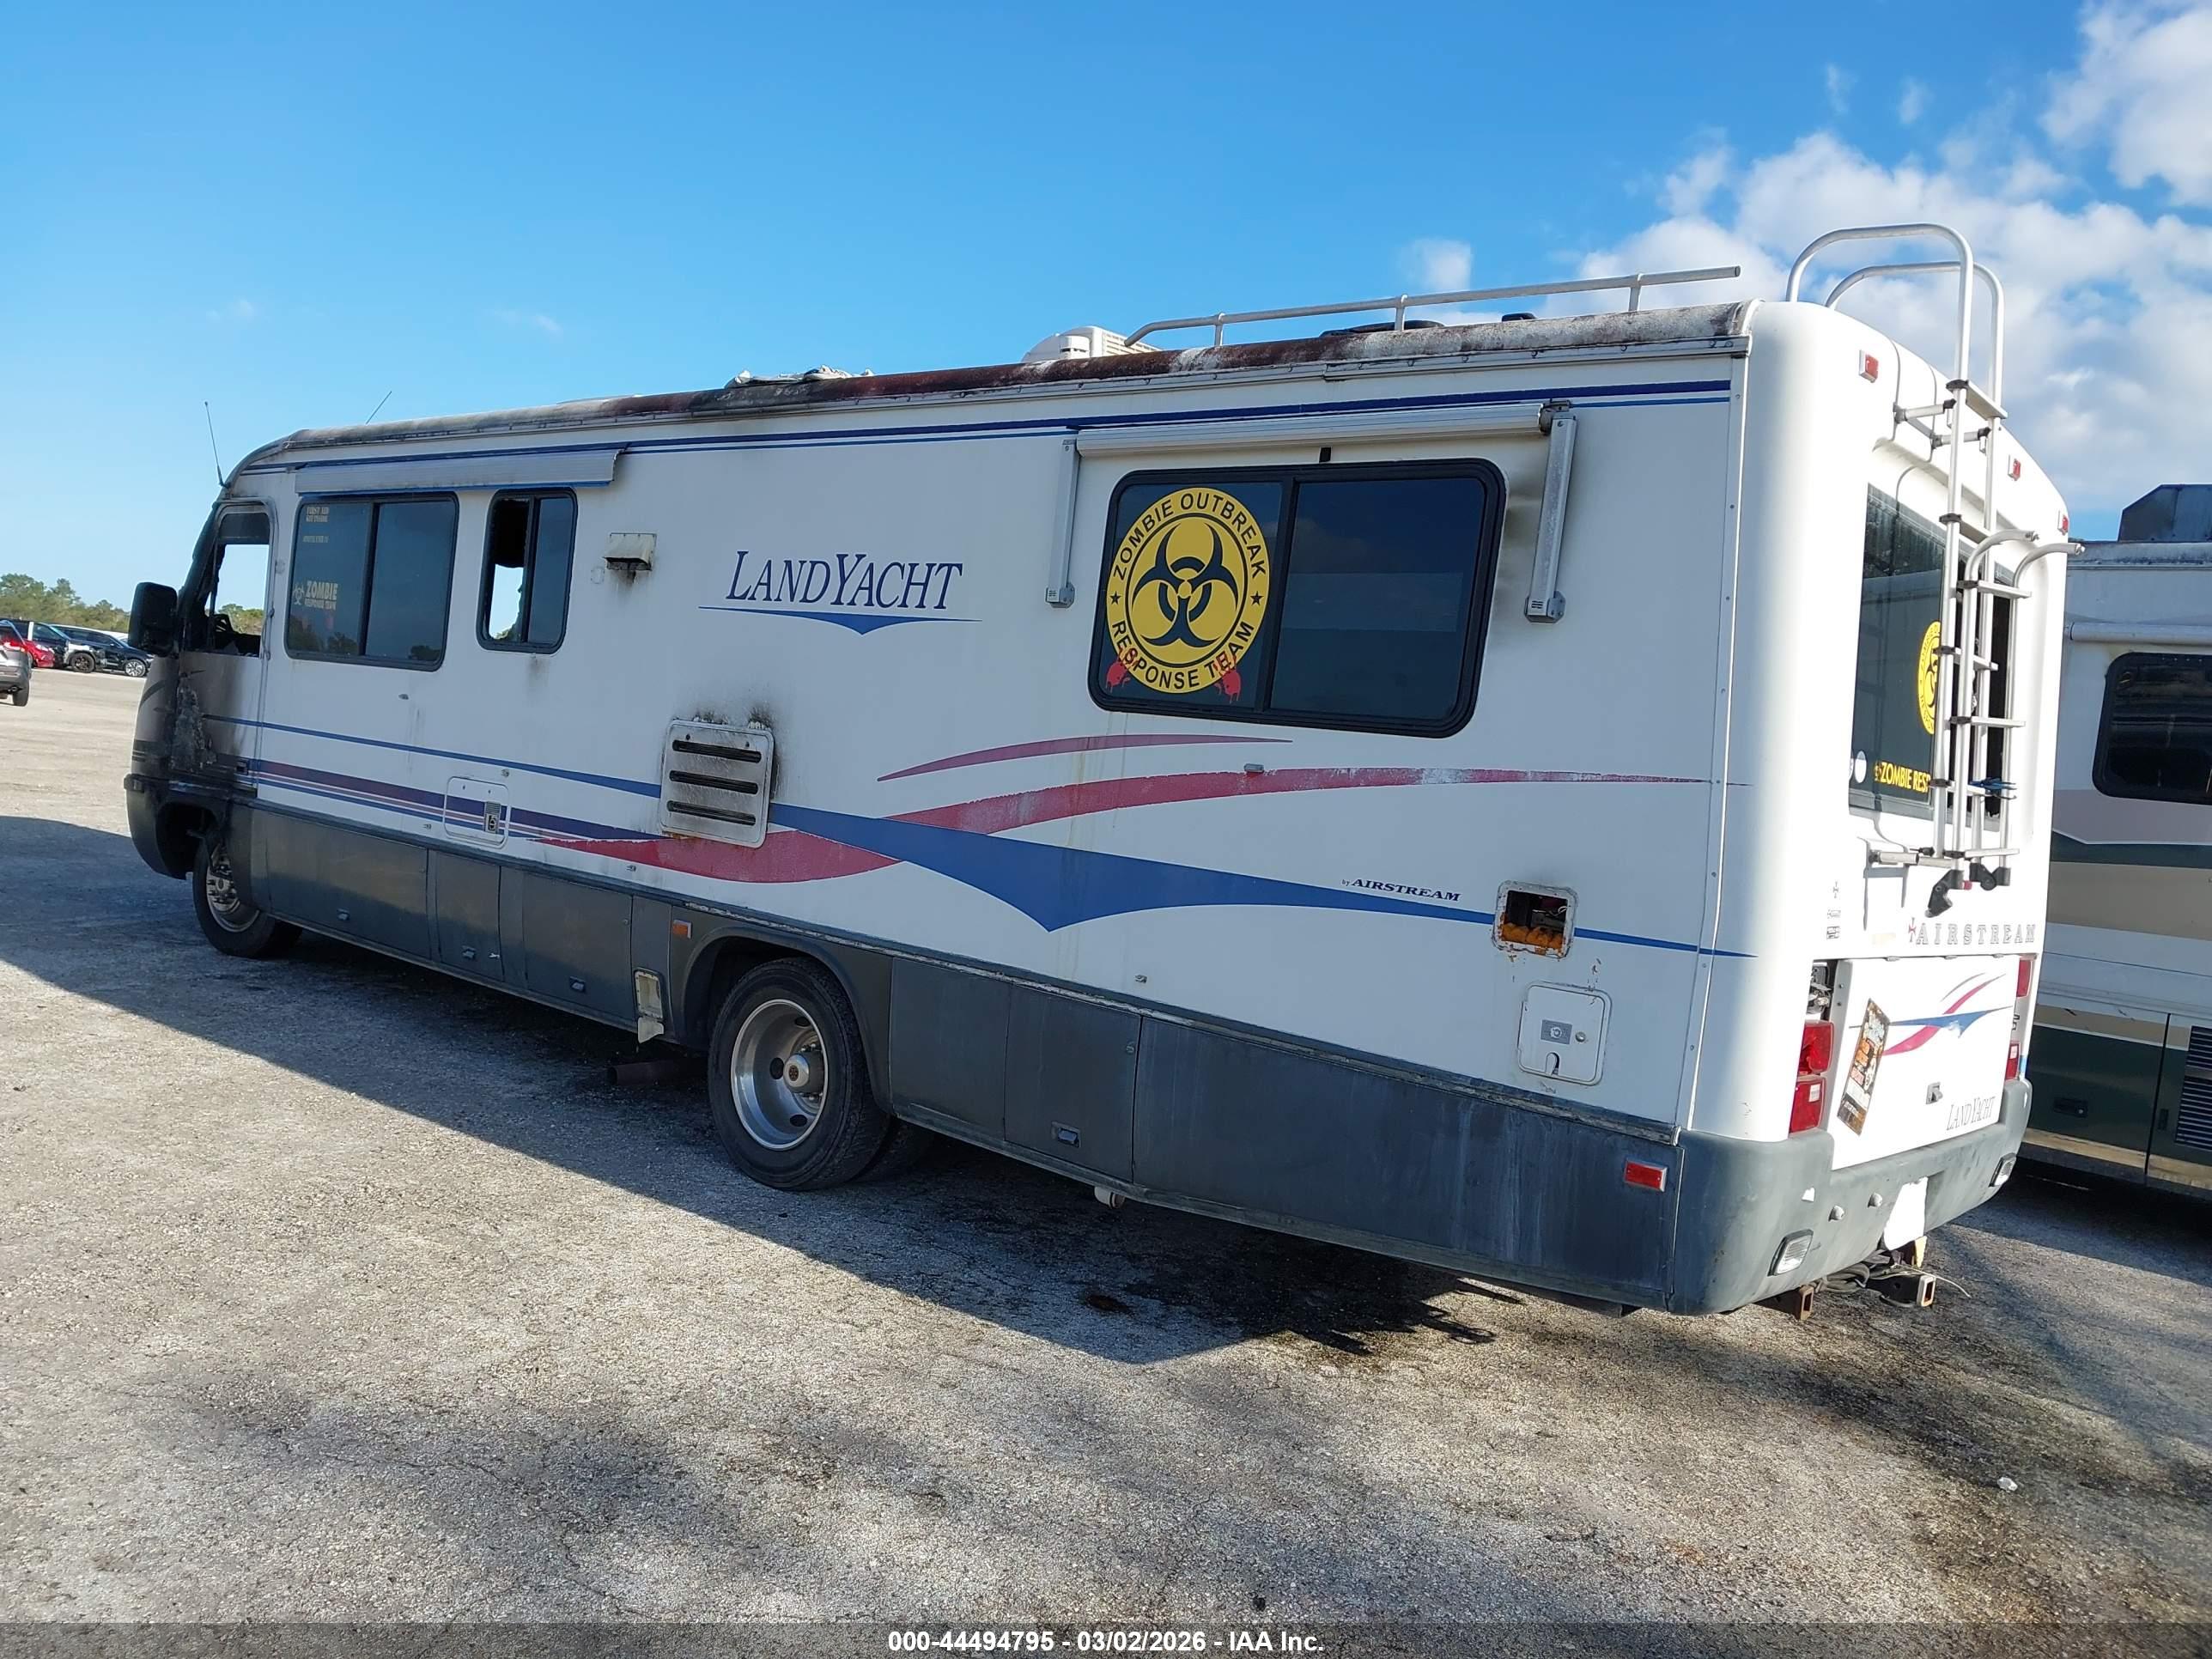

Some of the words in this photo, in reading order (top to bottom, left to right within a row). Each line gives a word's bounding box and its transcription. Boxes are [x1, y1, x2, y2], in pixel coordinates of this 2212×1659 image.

[1113, 499, 1174, 581] ZOMBIE
[1180, 491, 1267, 579] OUTBREAK
[306, 580, 338, 601] ZOMBIE
[1112, 620, 1200, 690] RESPONSE
[1204, 621, 1255, 679] TEAM
[1880, 761, 1912, 789] ZOMBIE
[1351, 878, 1462, 902] AIRSTREAM
[1916, 922, 2036, 945] AIRSTREAM
